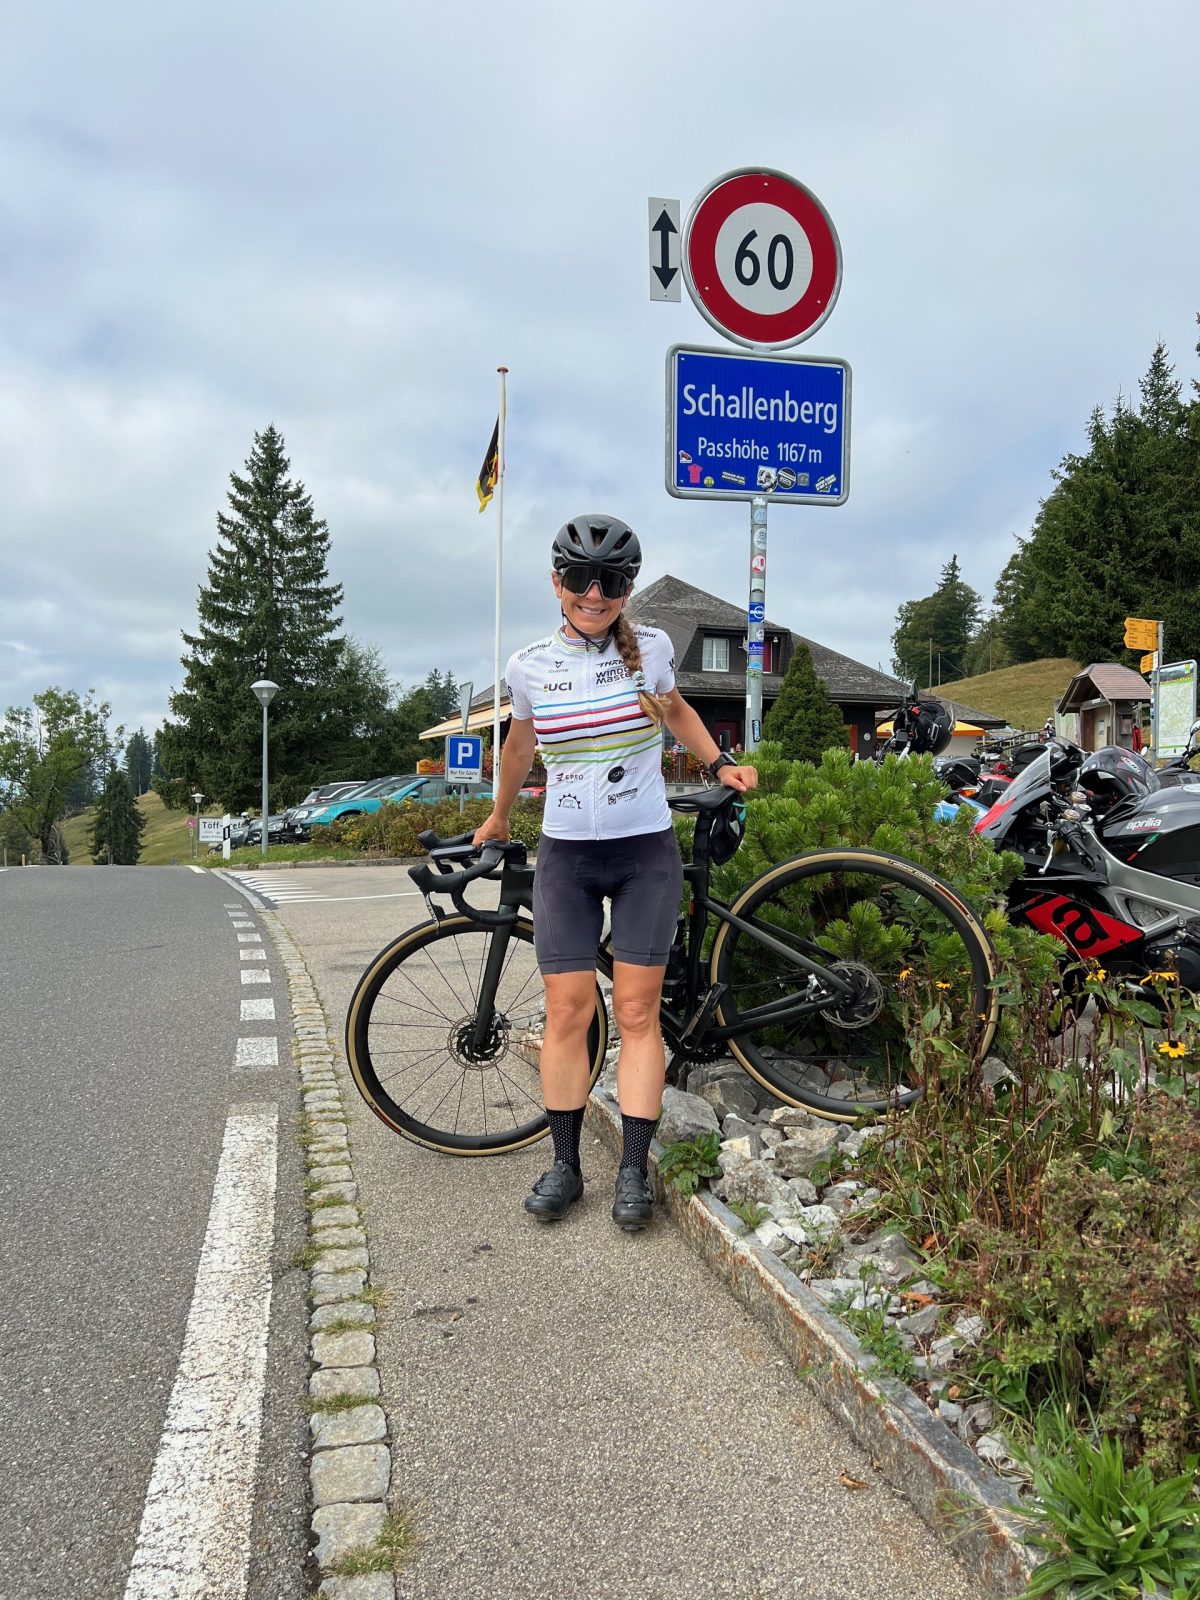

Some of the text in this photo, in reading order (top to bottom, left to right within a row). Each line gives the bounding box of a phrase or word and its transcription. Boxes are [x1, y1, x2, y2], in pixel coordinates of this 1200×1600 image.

[734, 229, 794, 291] 60
[682, 384, 838, 434] Schallenberg
[698, 436, 769, 461] Passhöhe
[549, 682, 572, 692] UCI
[457, 742, 473, 765] P
[1126, 817, 1162, 832] aprilia
